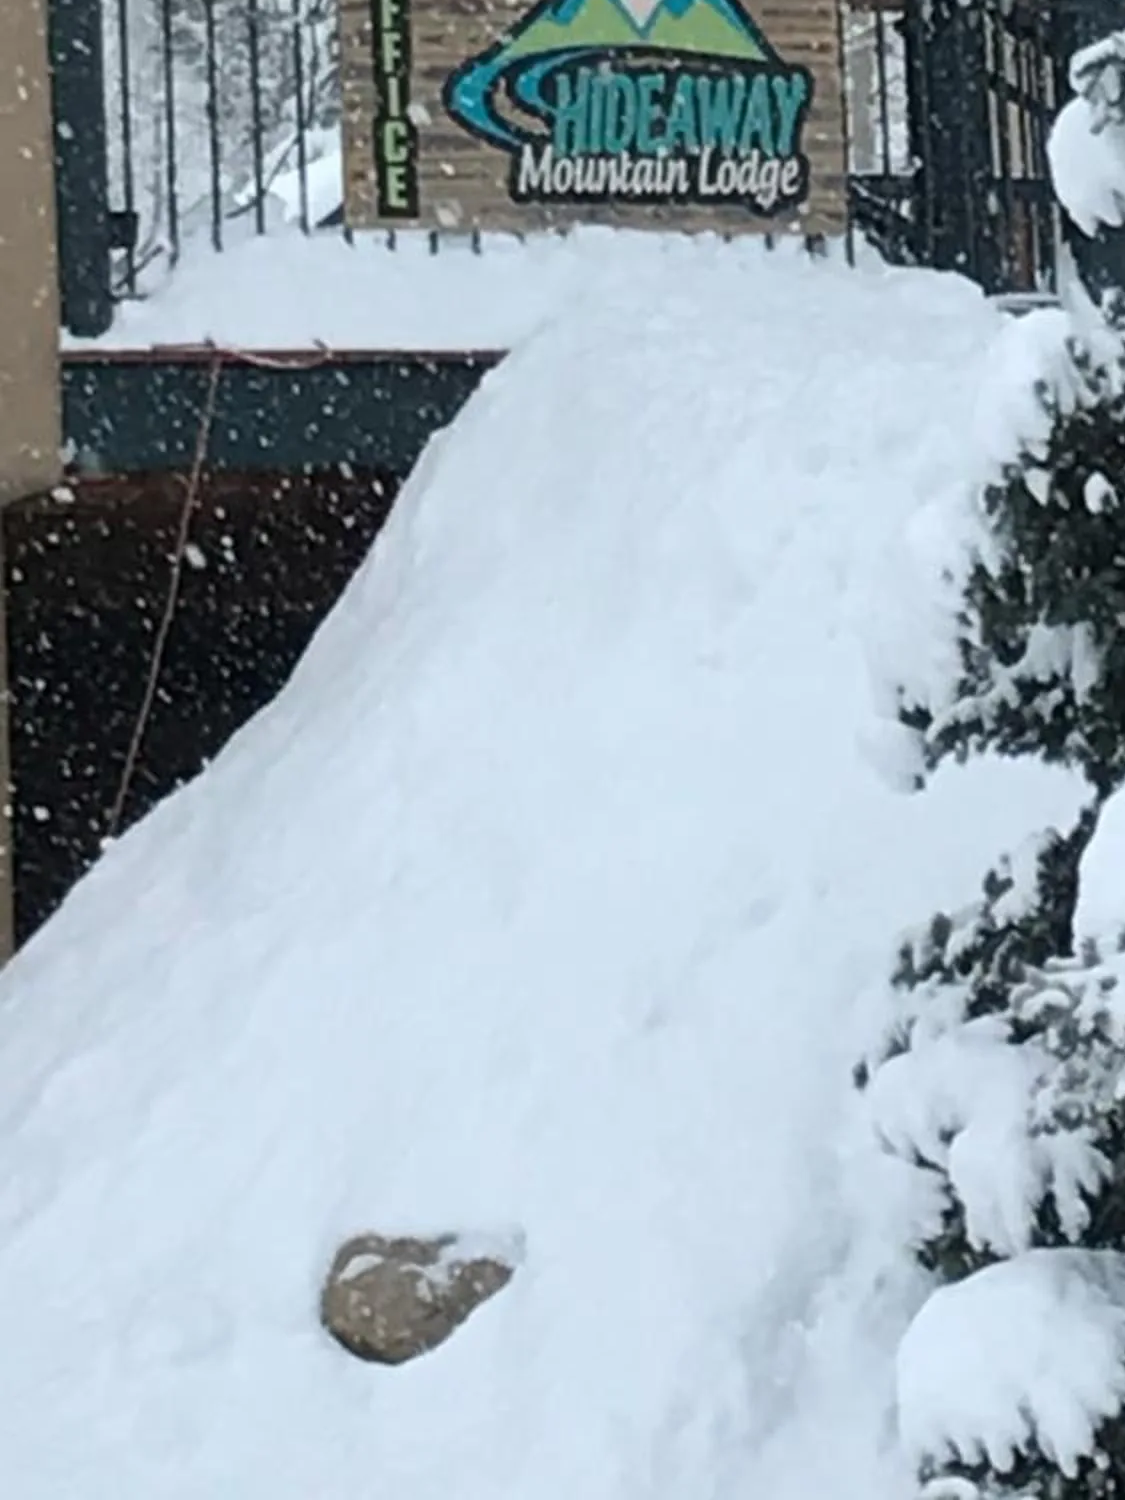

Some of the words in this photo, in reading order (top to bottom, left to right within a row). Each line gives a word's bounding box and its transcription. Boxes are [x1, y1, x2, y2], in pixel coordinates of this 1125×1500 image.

[553, 68, 806, 157] HIDEAWAY
[518, 145, 688, 195] Mountain
[700, 145, 800, 208] Lodge
